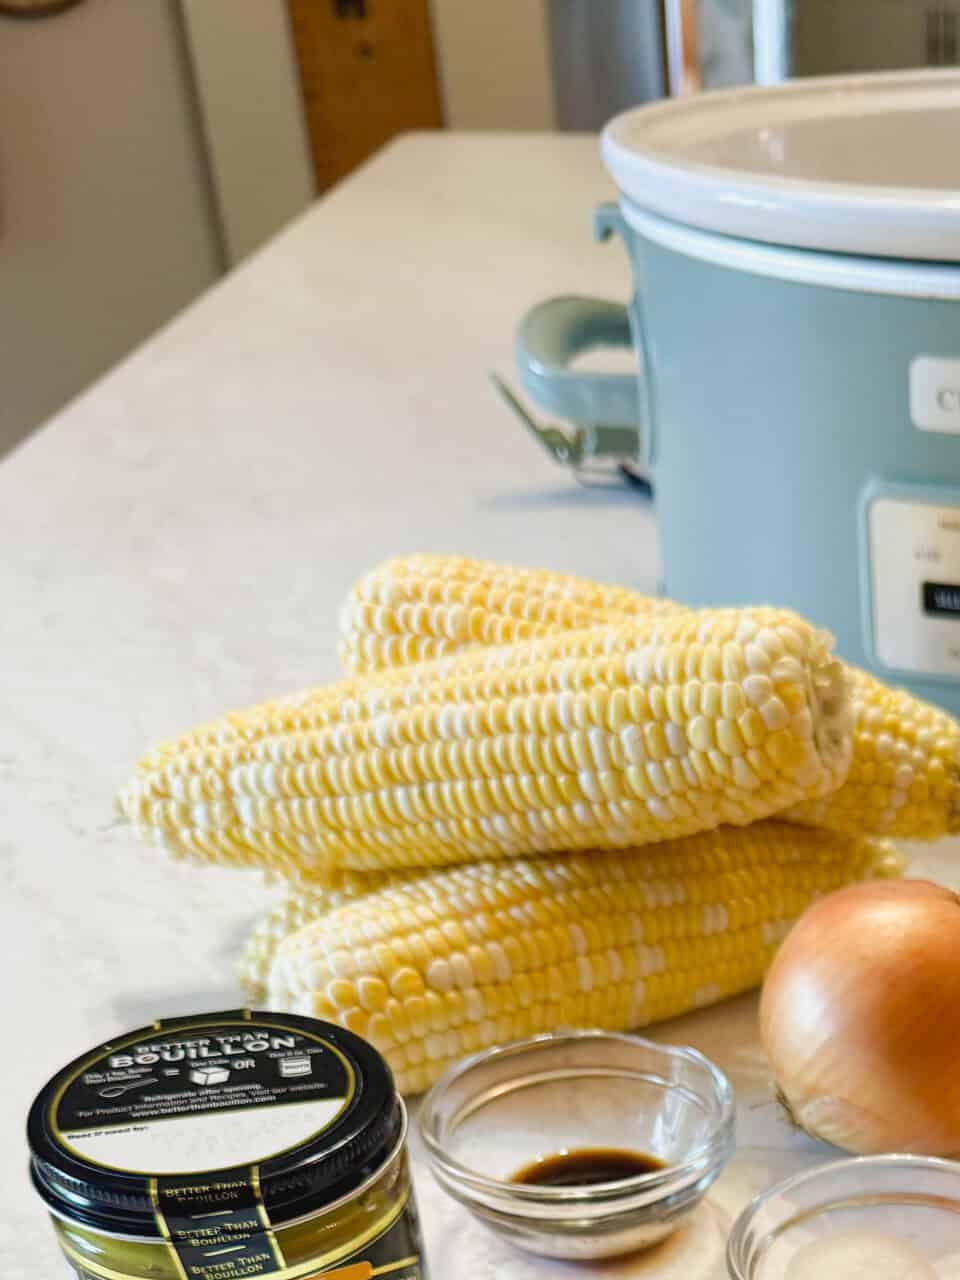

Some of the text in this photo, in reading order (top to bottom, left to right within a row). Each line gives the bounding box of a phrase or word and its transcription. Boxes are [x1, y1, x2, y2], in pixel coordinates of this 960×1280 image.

[135, 1031, 269, 1054] BETTER THAN
[110, 1036, 296, 1068] BOUILLON
[233, 1059, 256, 1069] OR
[165, 1180, 248, 1198] BETTER THAN
[176, 1220, 258, 1239] BETTER THAN
[191, 1233, 251, 1247] BOUILLON
[191, 1253, 271, 1274] BETTER THAN
[205, 1263, 263, 1280] BOUILLON
